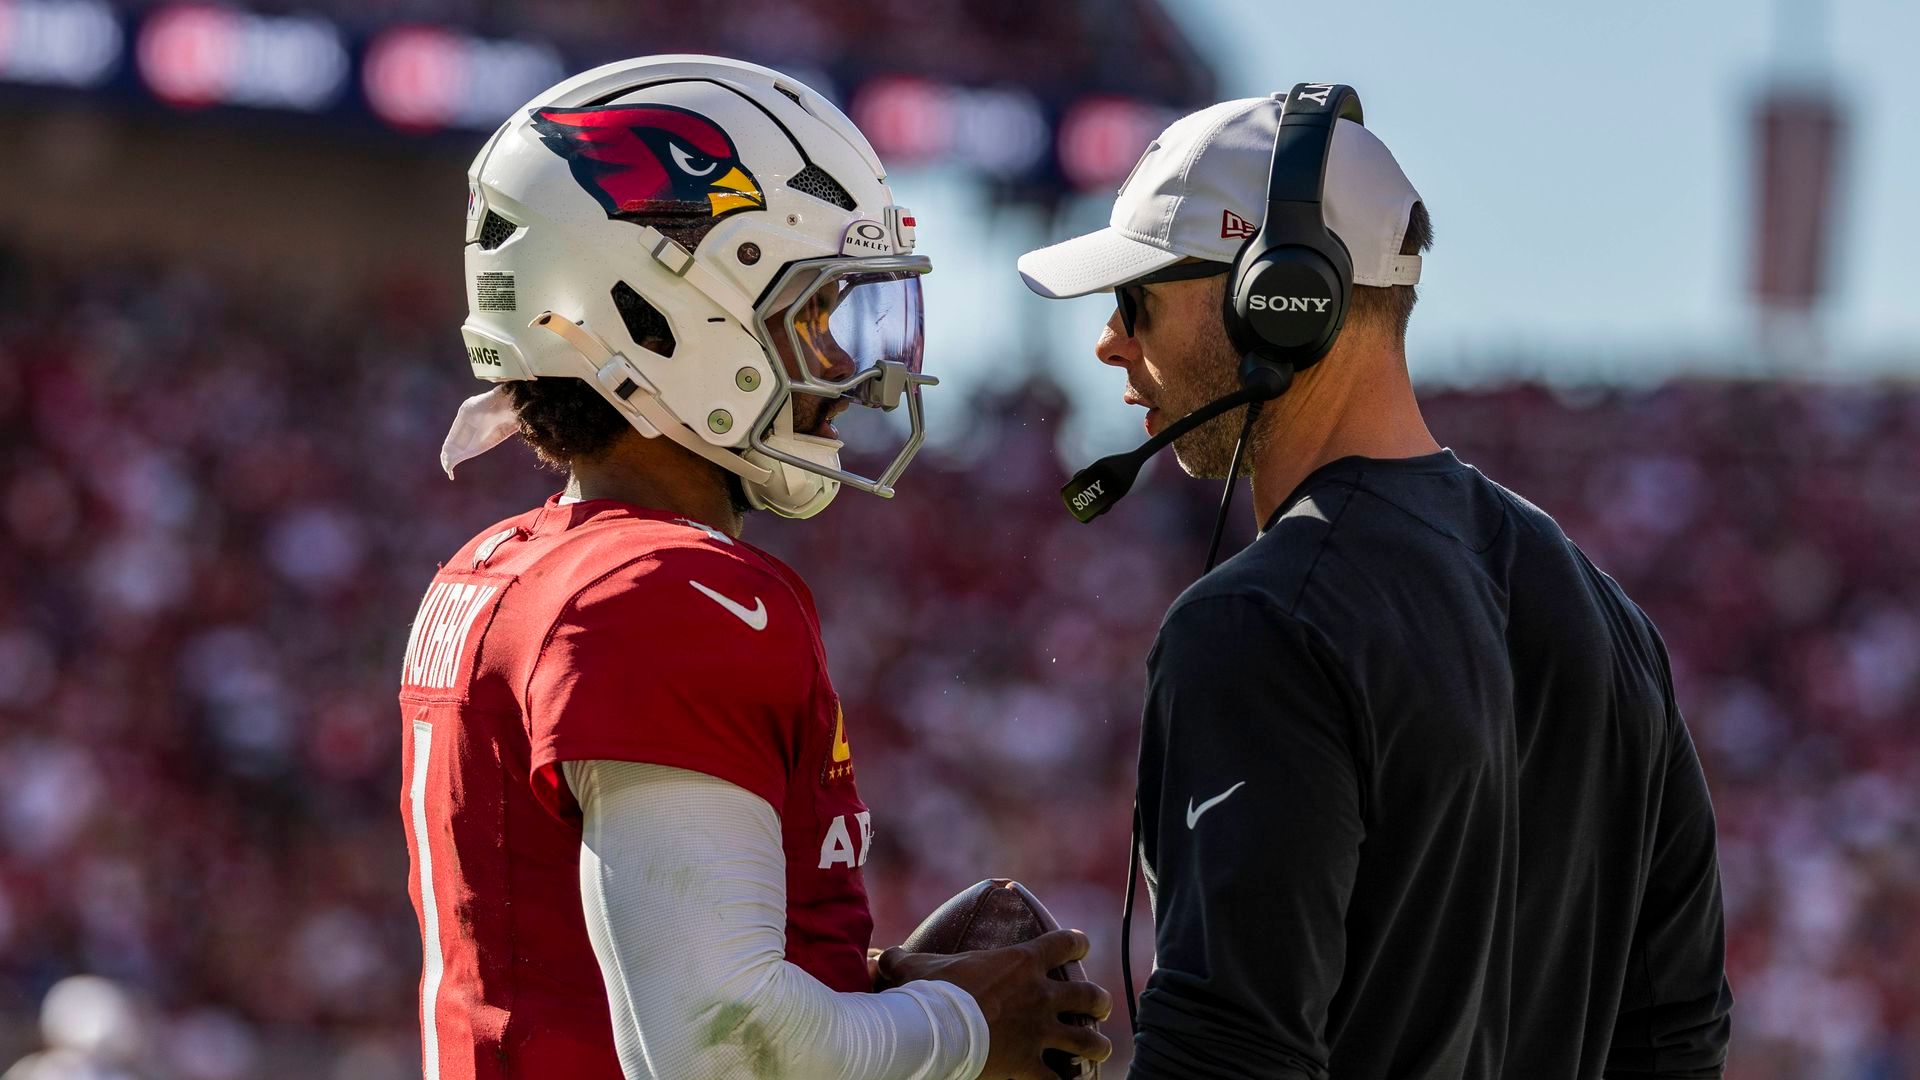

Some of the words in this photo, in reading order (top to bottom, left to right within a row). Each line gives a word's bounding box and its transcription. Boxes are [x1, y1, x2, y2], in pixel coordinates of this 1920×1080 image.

[846, 237, 889, 252] OAKLEY
[1249, 294, 1331, 312] SONY
[1072, 479, 1105, 511] SONY
